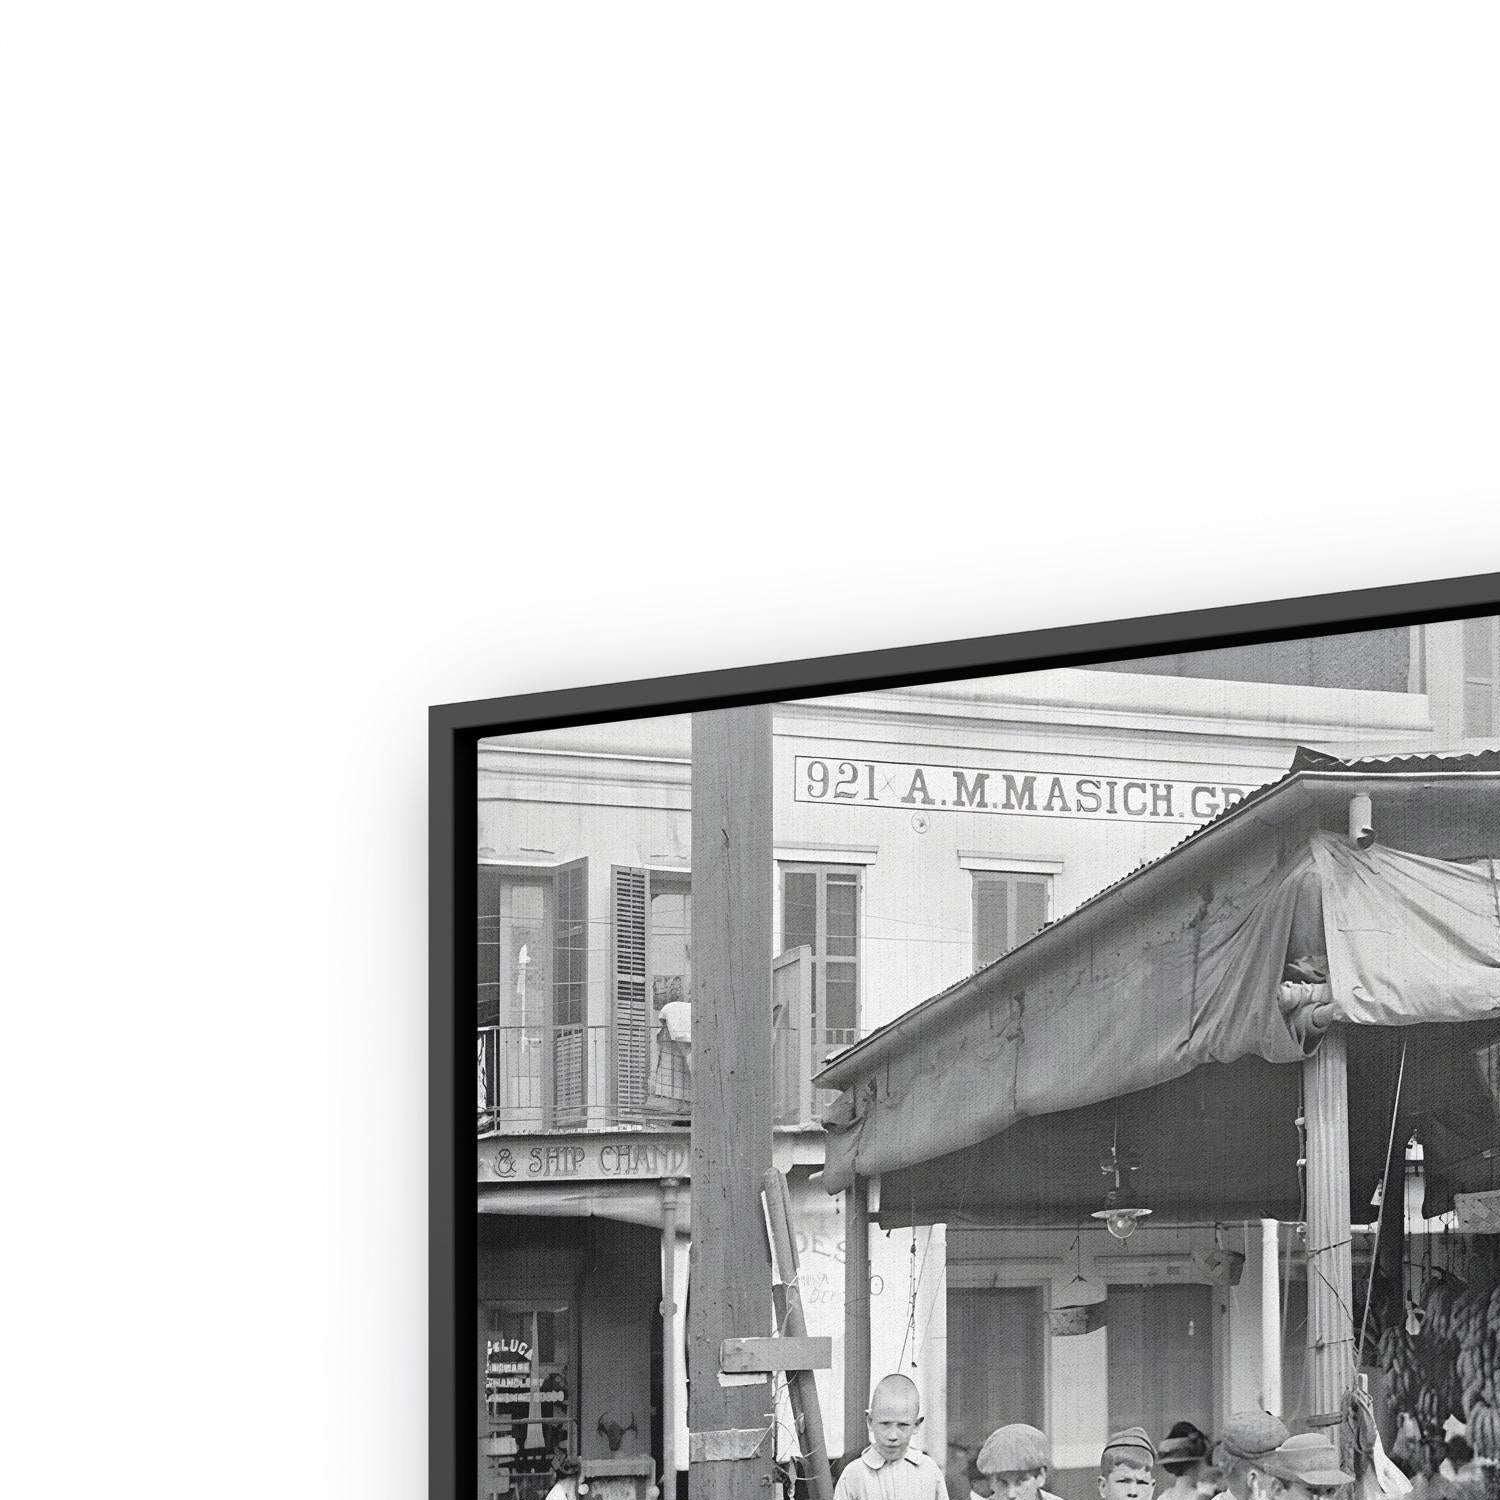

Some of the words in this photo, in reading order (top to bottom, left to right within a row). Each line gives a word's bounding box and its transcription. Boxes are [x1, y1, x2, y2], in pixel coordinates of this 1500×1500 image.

[807, 760, 880, 801] 921
[493, 1148, 517, 1178] &
[528, 1147, 585, 1176] SHIP
